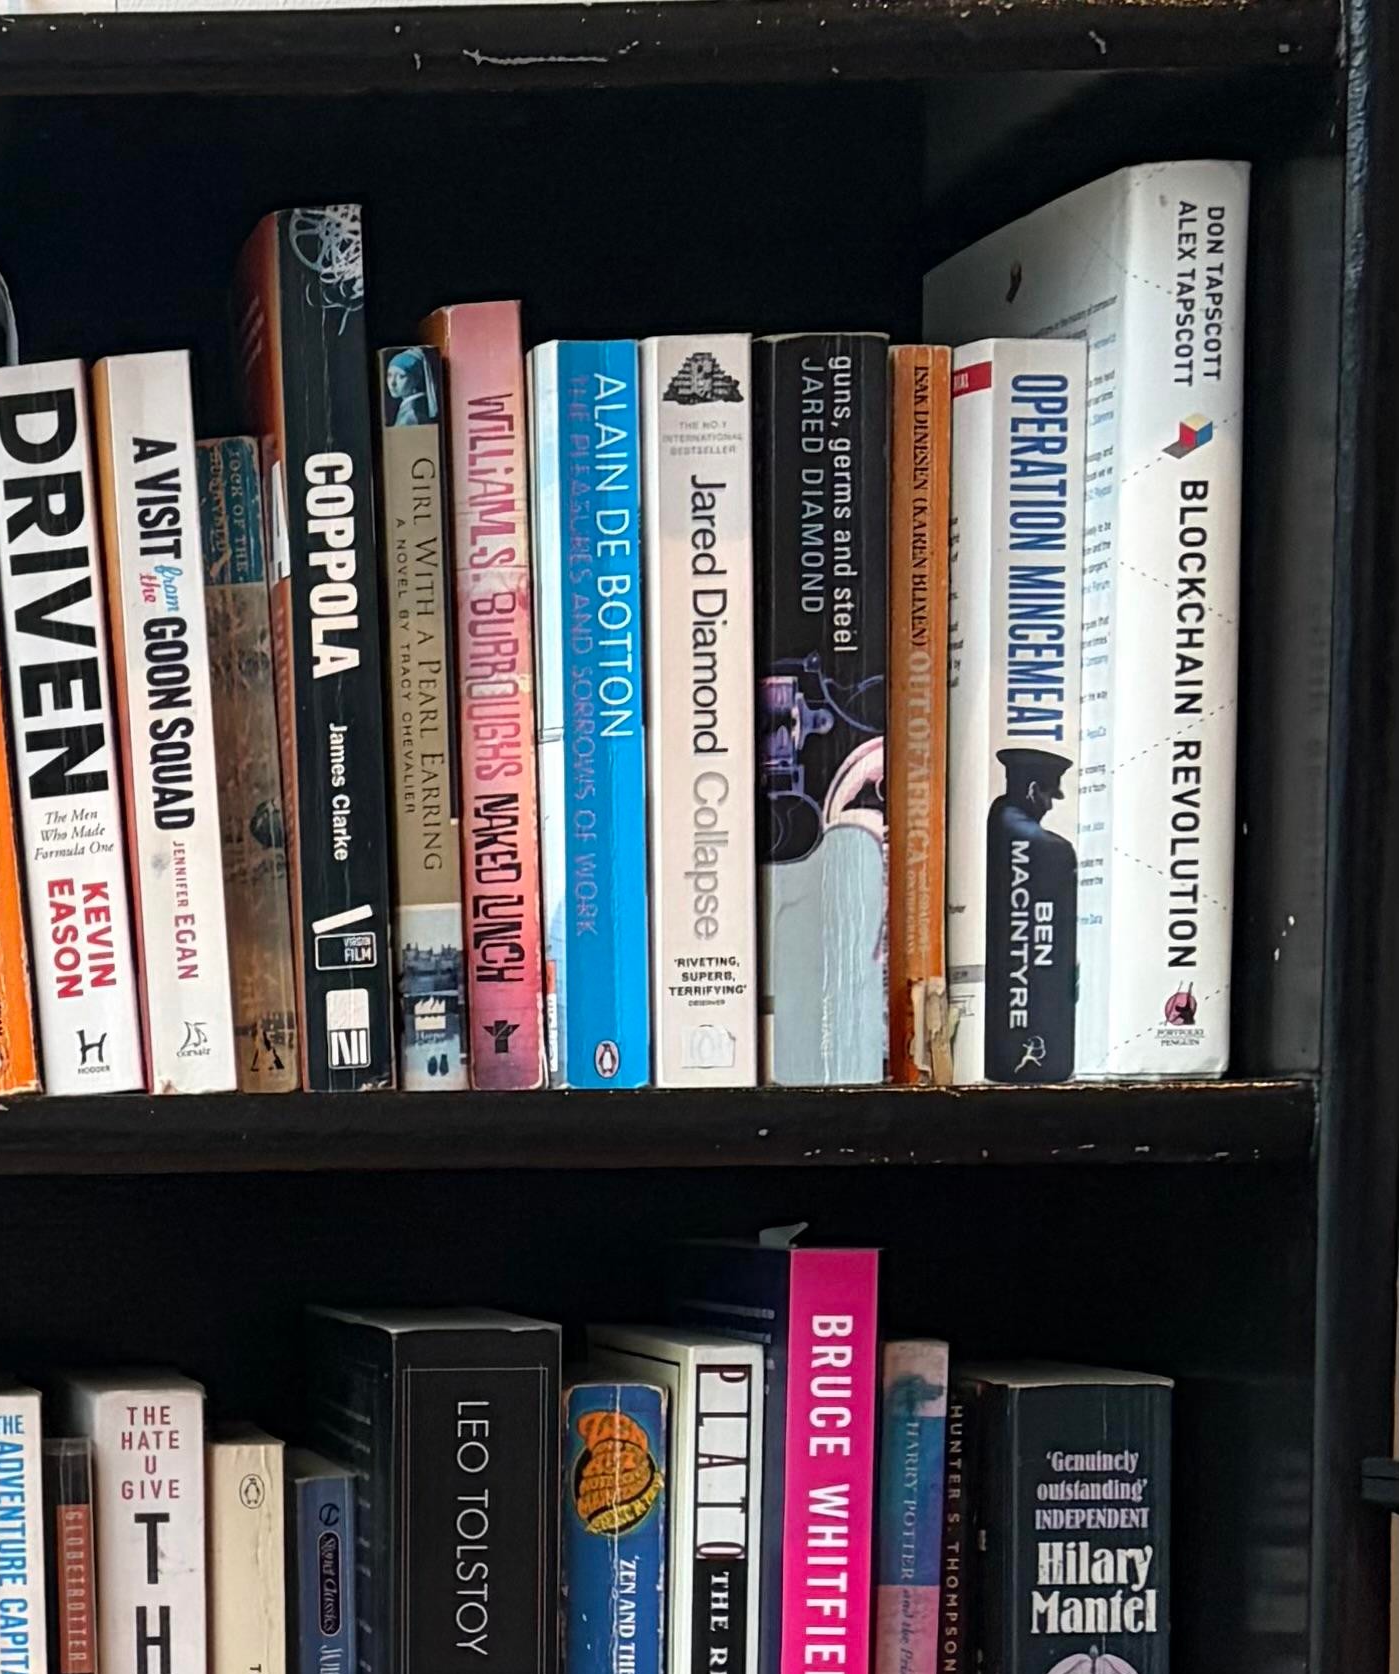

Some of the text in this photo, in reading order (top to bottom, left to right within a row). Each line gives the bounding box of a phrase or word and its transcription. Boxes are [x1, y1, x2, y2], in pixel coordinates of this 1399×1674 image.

[305, 452, 360, 679] COPPOLA
[692, 474, 729, 754] Jared Diamond
[1007, 374, 1068, 741] OPERATION MINCEMEAT
[143, 618, 195, 831] GOON SQUAD
[1168, 480, 1209, 969] BLOCKCHAIN REVOLUTION
[48, 879, 83, 1000] EASON
[82, 882, 116, 987] KEVIN
[173, 842, 199, 980] JENNIFER EGAN
[682, 972, 736, 983] SUPERB,
[1009, 840, 1030, 1030] MACINTYRE
[1034, 902, 1053, 967] BEN
[809, 1316, 853, 1456] BRUCE
[456, 1401, 489, 1656] LEO TOLSTOY
[1036, 1509, 1150, 1530] INDEPENDENT
[1037, 1542, 1152, 1590] Hilary
[1031, 1589, 1158, 1635] Mantel
